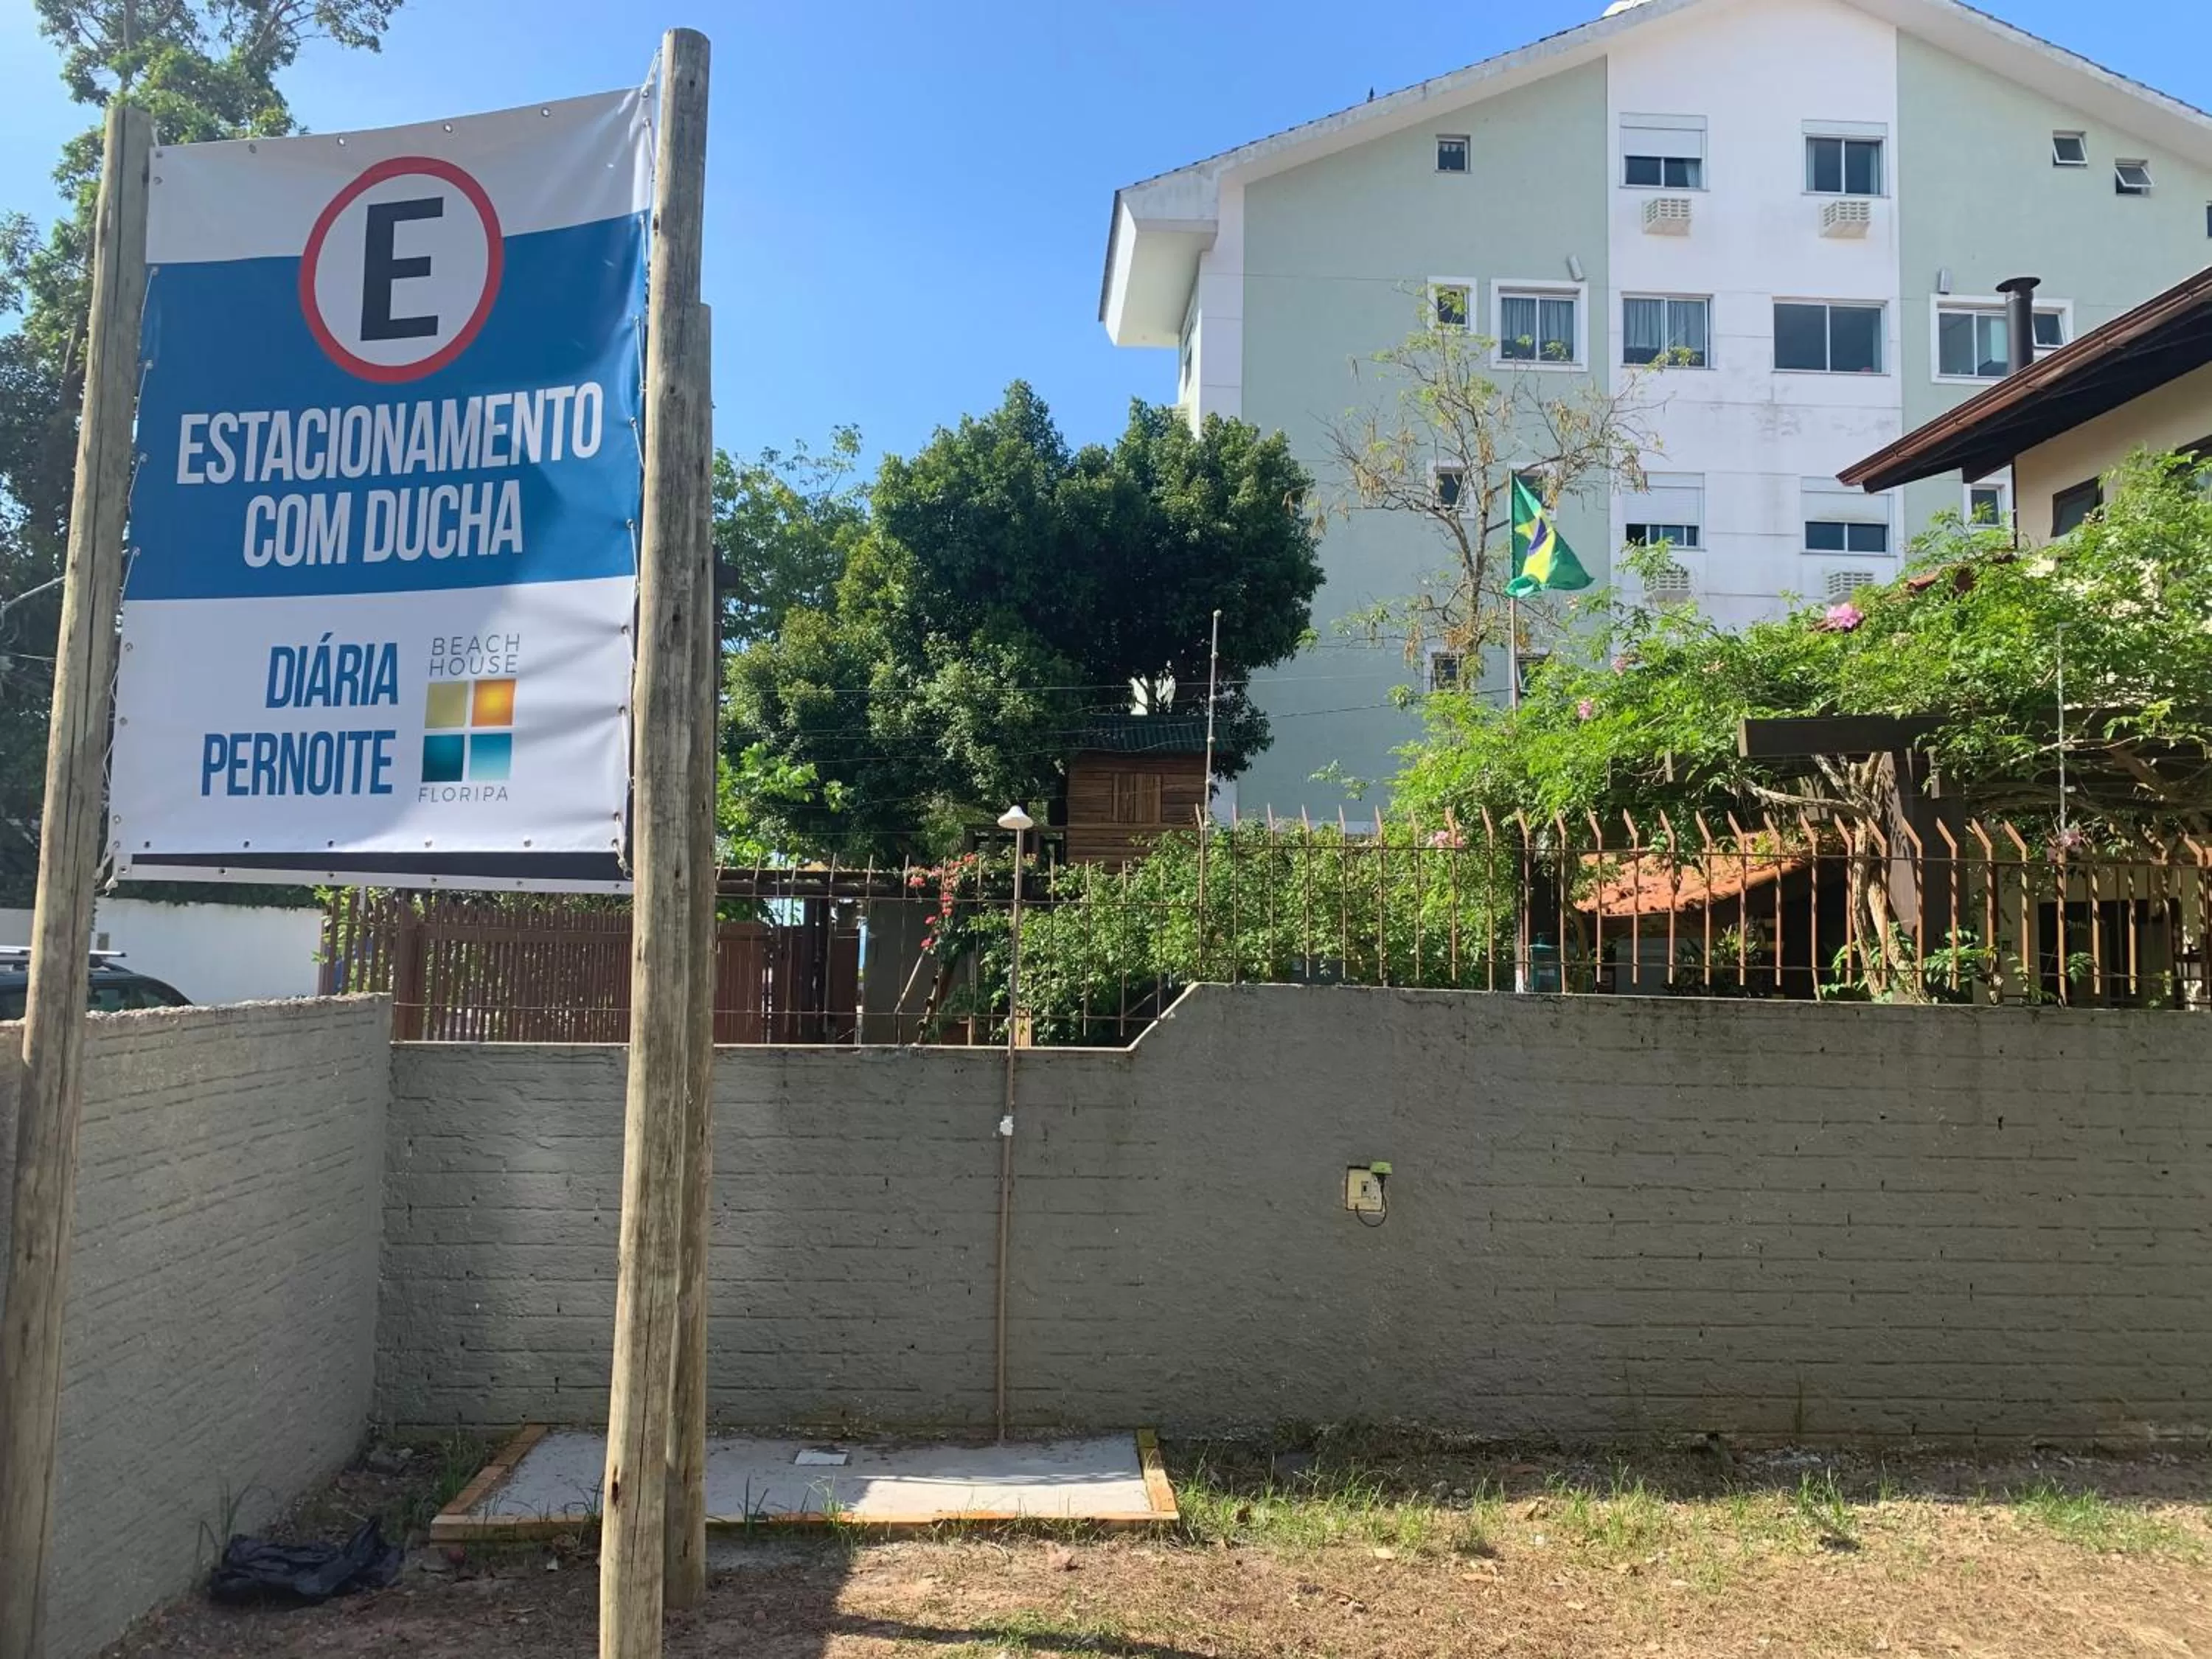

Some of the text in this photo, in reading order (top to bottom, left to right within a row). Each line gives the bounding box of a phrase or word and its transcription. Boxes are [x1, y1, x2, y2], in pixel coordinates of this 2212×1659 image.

[360, 197, 444, 341] E
[177, 382, 602, 484] ESTACIONAMENTO
[243, 479, 523, 568] COM DUCHA
[266, 632, 398, 709] DIÁRIA
[428, 655, 518, 676] HOUSE
[431, 633, 521, 655] BEACH
[201, 730, 396, 796] PERNOITE
[418, 785, 509, 804] FLORIPA
